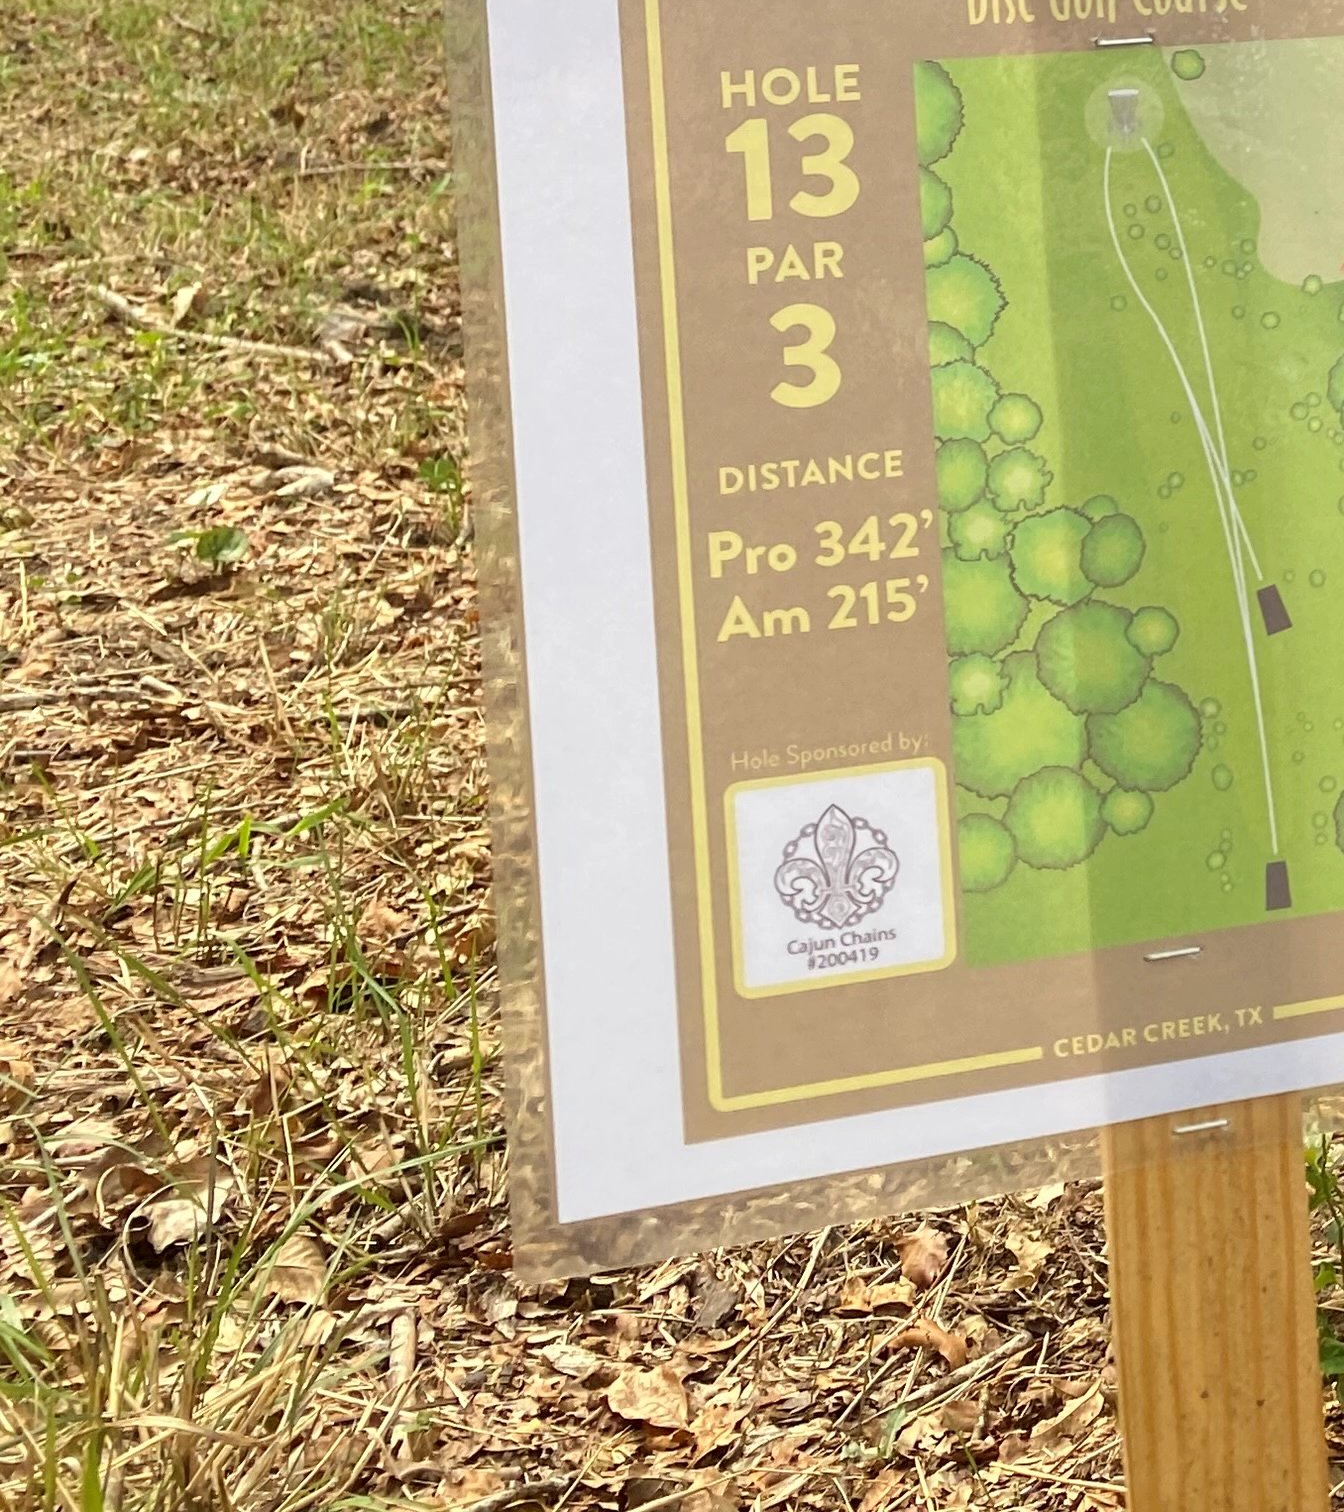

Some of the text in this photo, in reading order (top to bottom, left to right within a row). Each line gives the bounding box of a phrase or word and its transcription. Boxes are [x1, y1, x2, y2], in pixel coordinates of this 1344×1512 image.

[720, 64, 862, 109] HOLE
[725, 113, 860, 221] 13
[747, 242, 844, 285] PAR
[769, 303, 842, 409] 3
[718, 449, 904, 495] DISTANCE
[708, 508, 934, 579] Pro 342'
[717, 574, 930, 643] Am 215'
[731, 730, 930, 772] Hole Sponsored by:
[787, 928, 897, 956] Cajun Chains
[808, 946, 880, 971] #200419
[1053, 1005, 1264, 1058] CEDAR CREEK, TX
